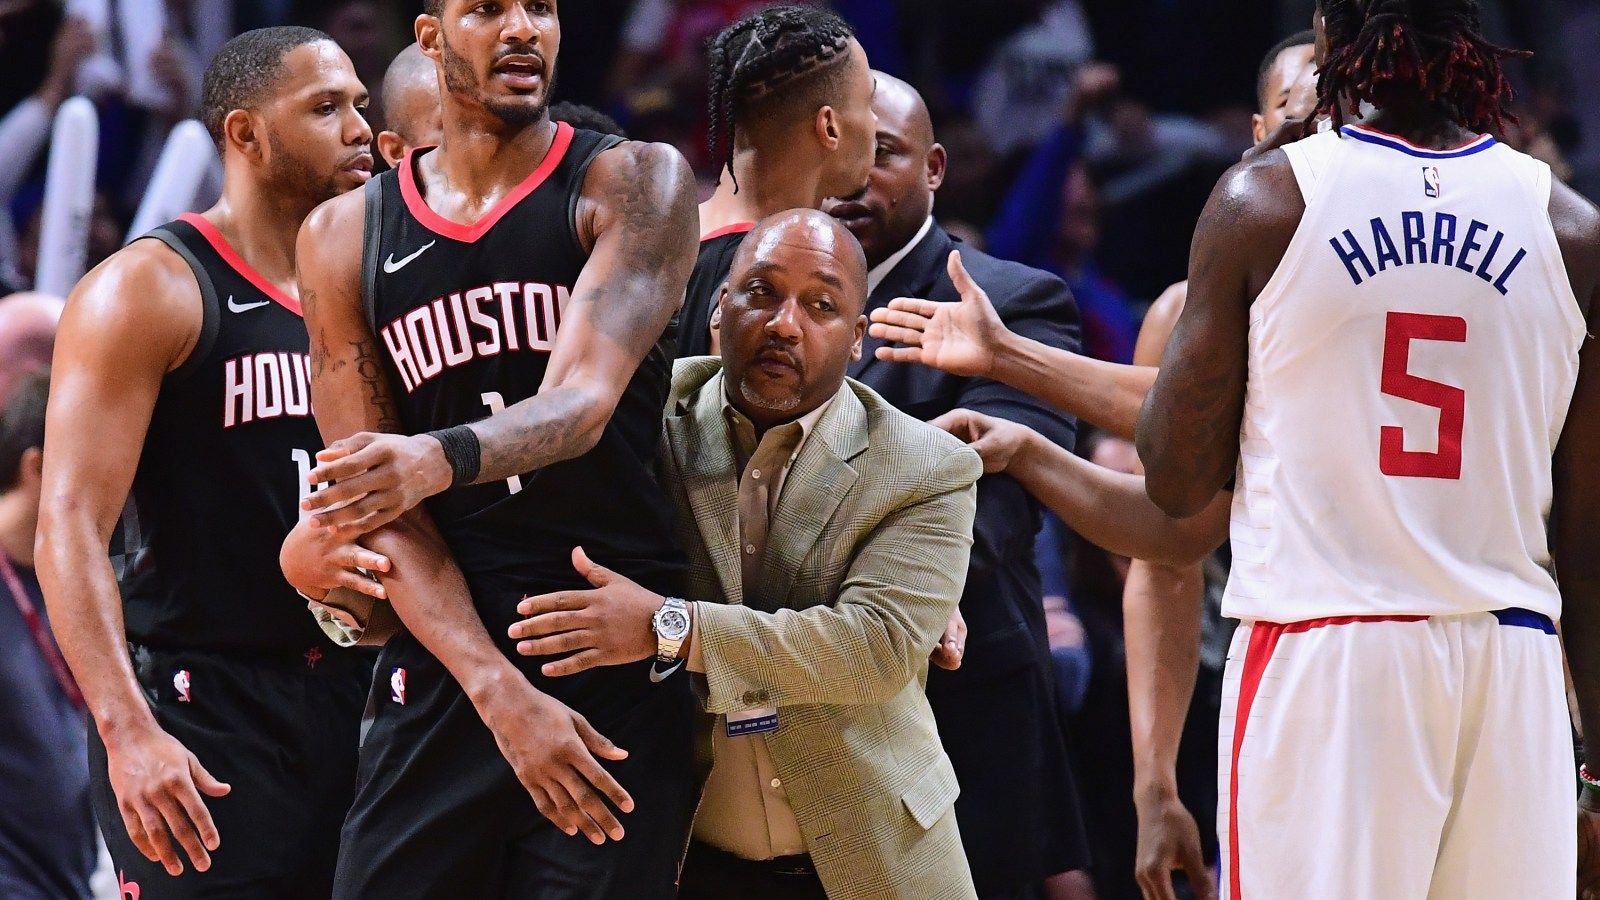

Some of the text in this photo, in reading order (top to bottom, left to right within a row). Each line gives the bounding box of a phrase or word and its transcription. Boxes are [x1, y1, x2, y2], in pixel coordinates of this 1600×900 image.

[1329, 211, 1527, 296] HARRELL
[223, 352, 315, 429] HOU
[1379, 311, 1468, 480] 5
